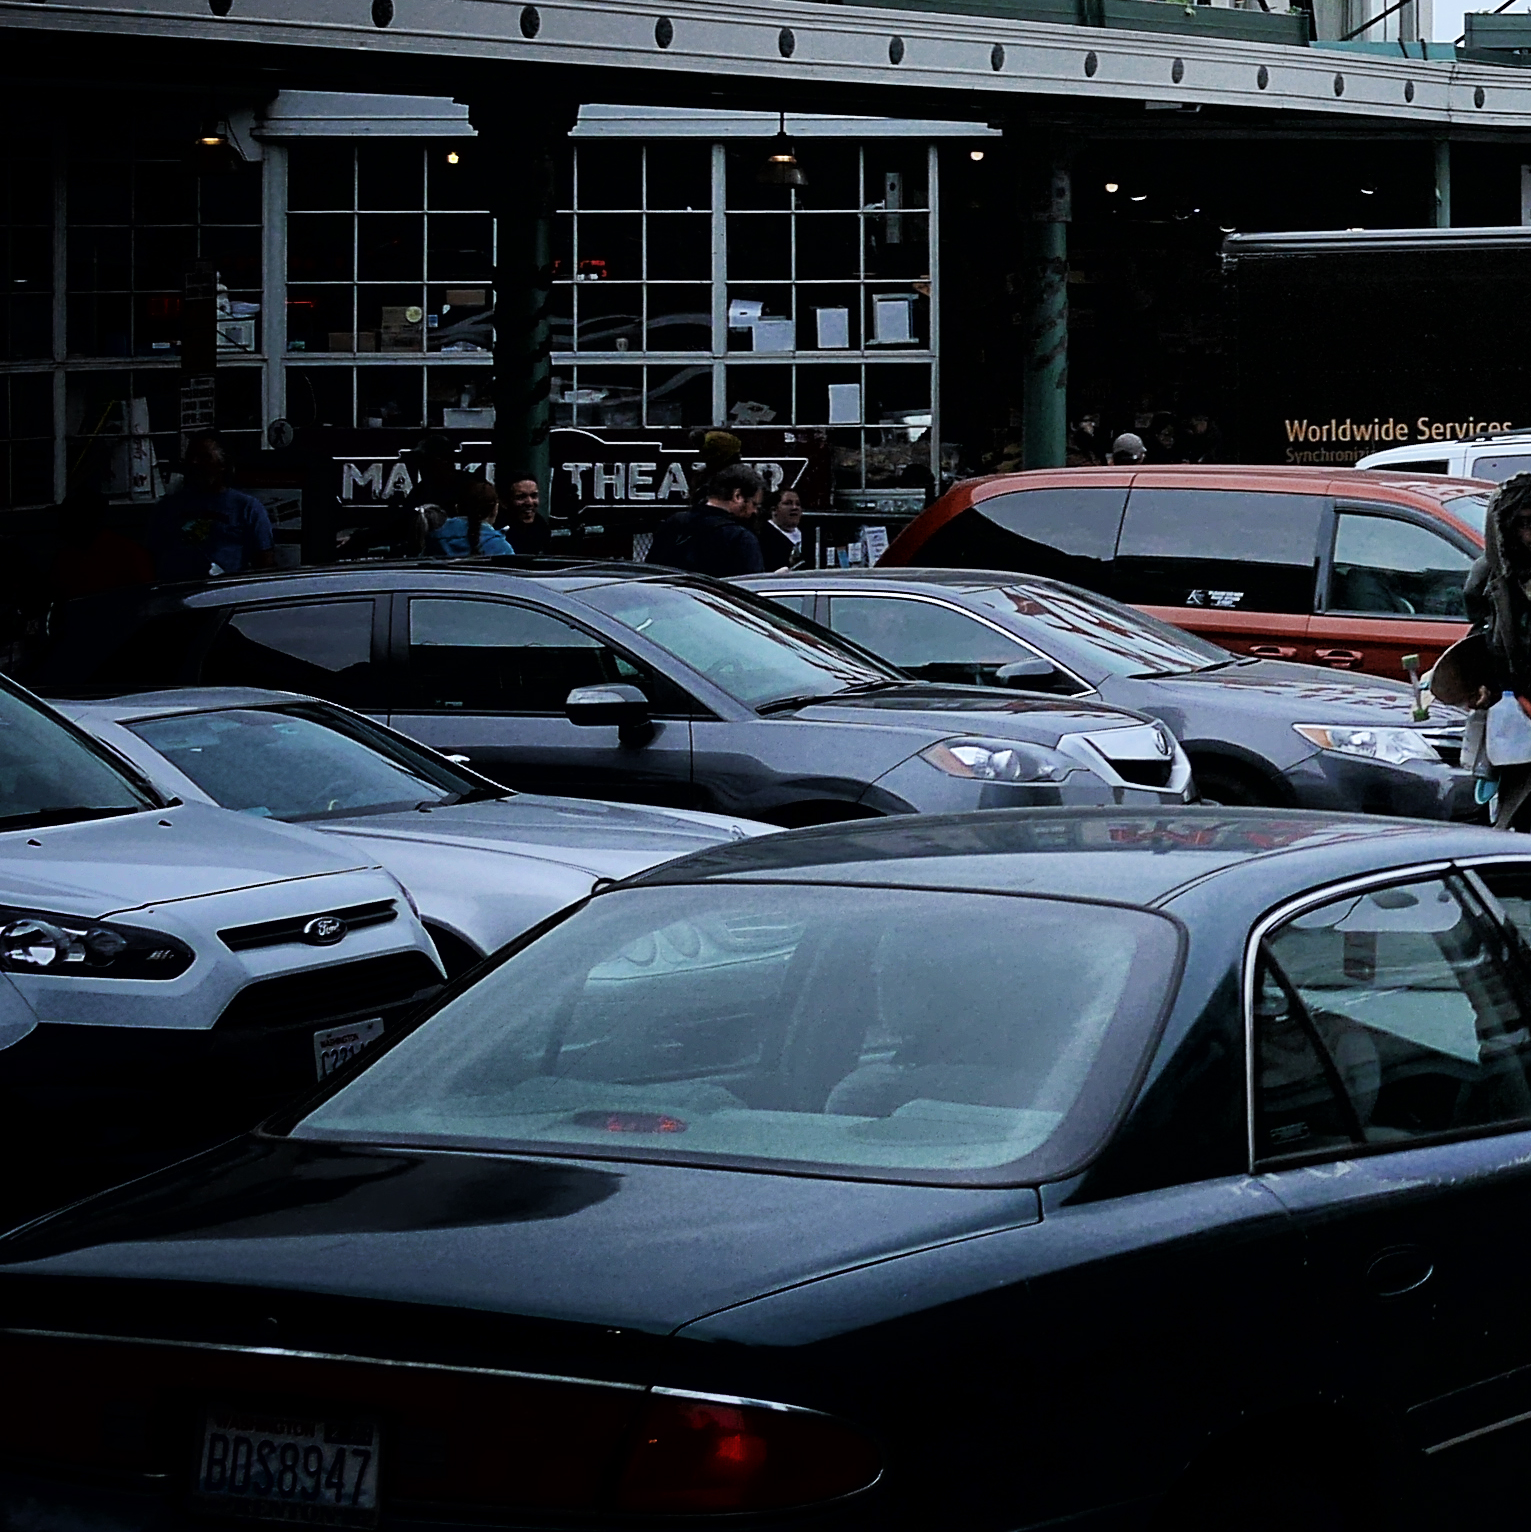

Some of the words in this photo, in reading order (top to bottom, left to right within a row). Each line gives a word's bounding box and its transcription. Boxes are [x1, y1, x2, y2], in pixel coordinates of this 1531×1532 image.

[1284, 417, 1409, 442] Worldwide
[1416, 416, 1514, 440] Services
[316, 919, 341, 937] Ford
[319, 1033, 360, 1049] WASHINGTON
[204, 1432, 371, 1506] BDS8947
